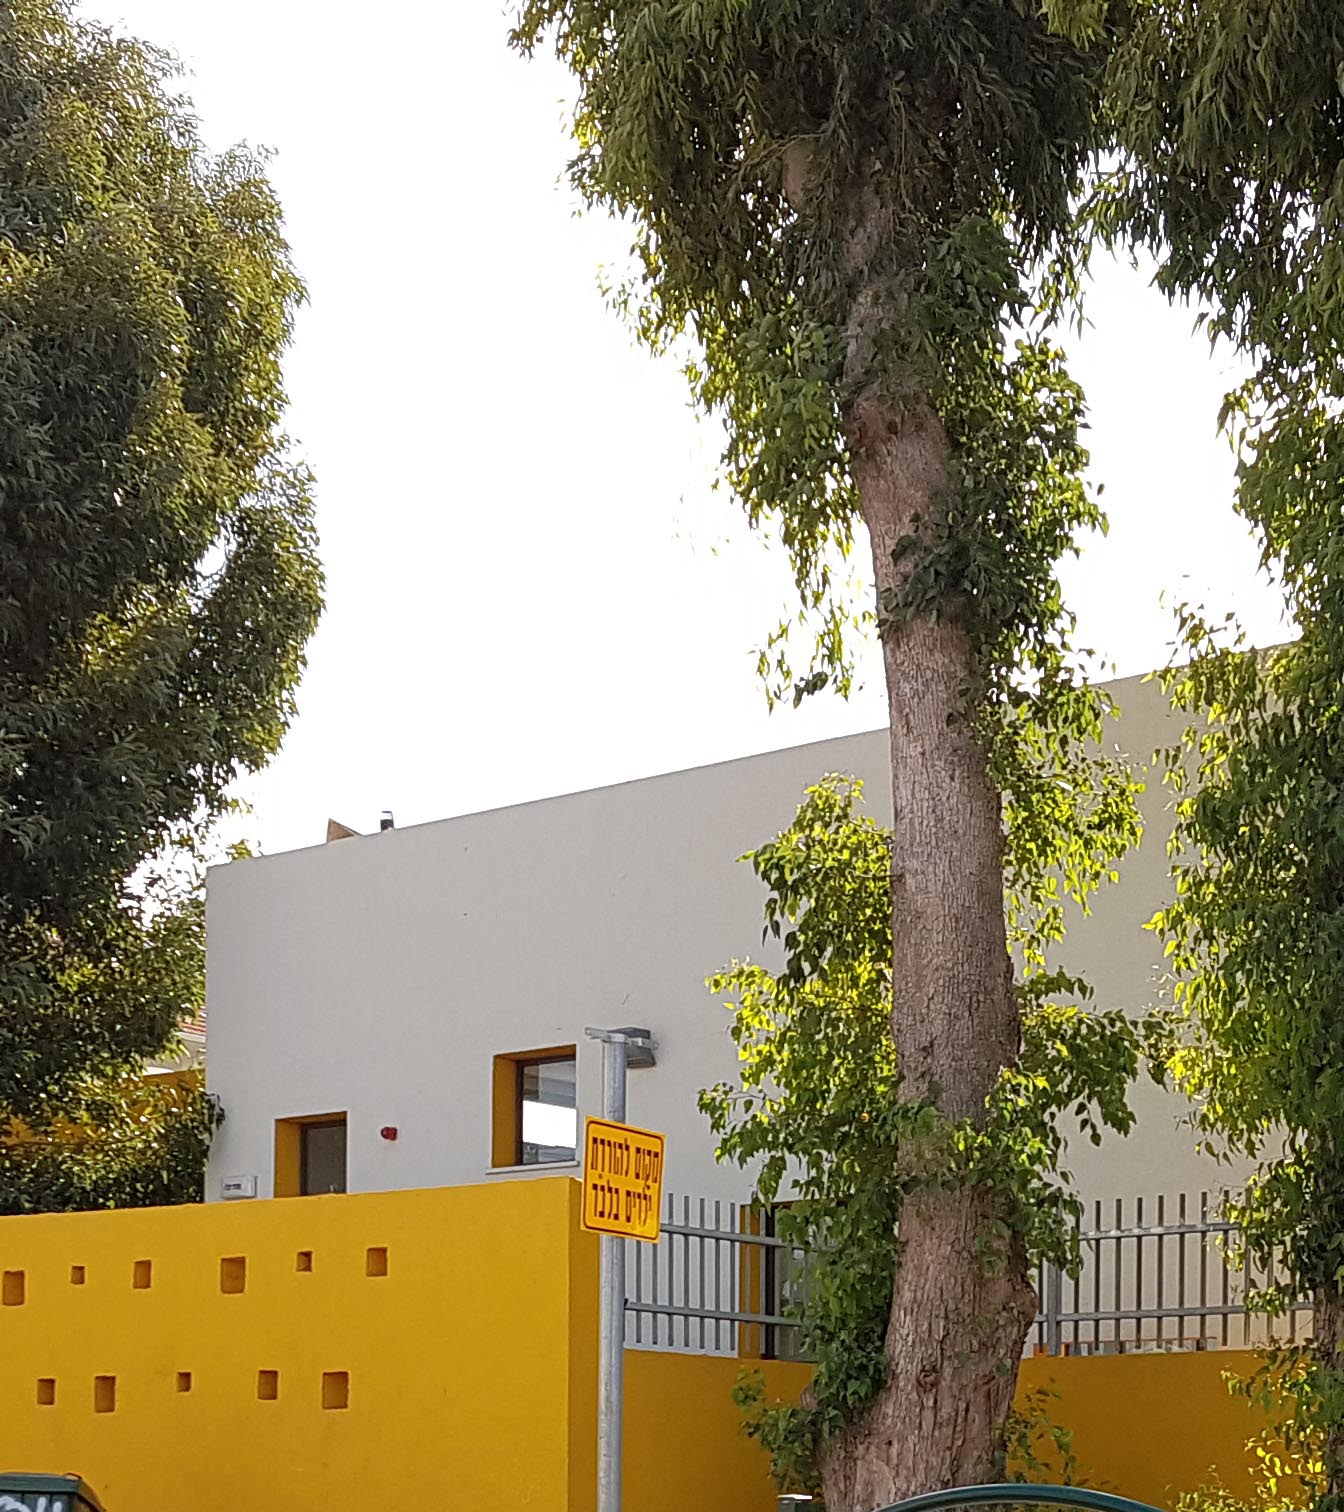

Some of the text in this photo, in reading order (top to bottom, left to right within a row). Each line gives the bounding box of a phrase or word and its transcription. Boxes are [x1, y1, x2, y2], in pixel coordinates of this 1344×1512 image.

[591, 1136, 659, 1184] מקום להורדת
[592, 1178, 652, 1227] ילדים בלבד
